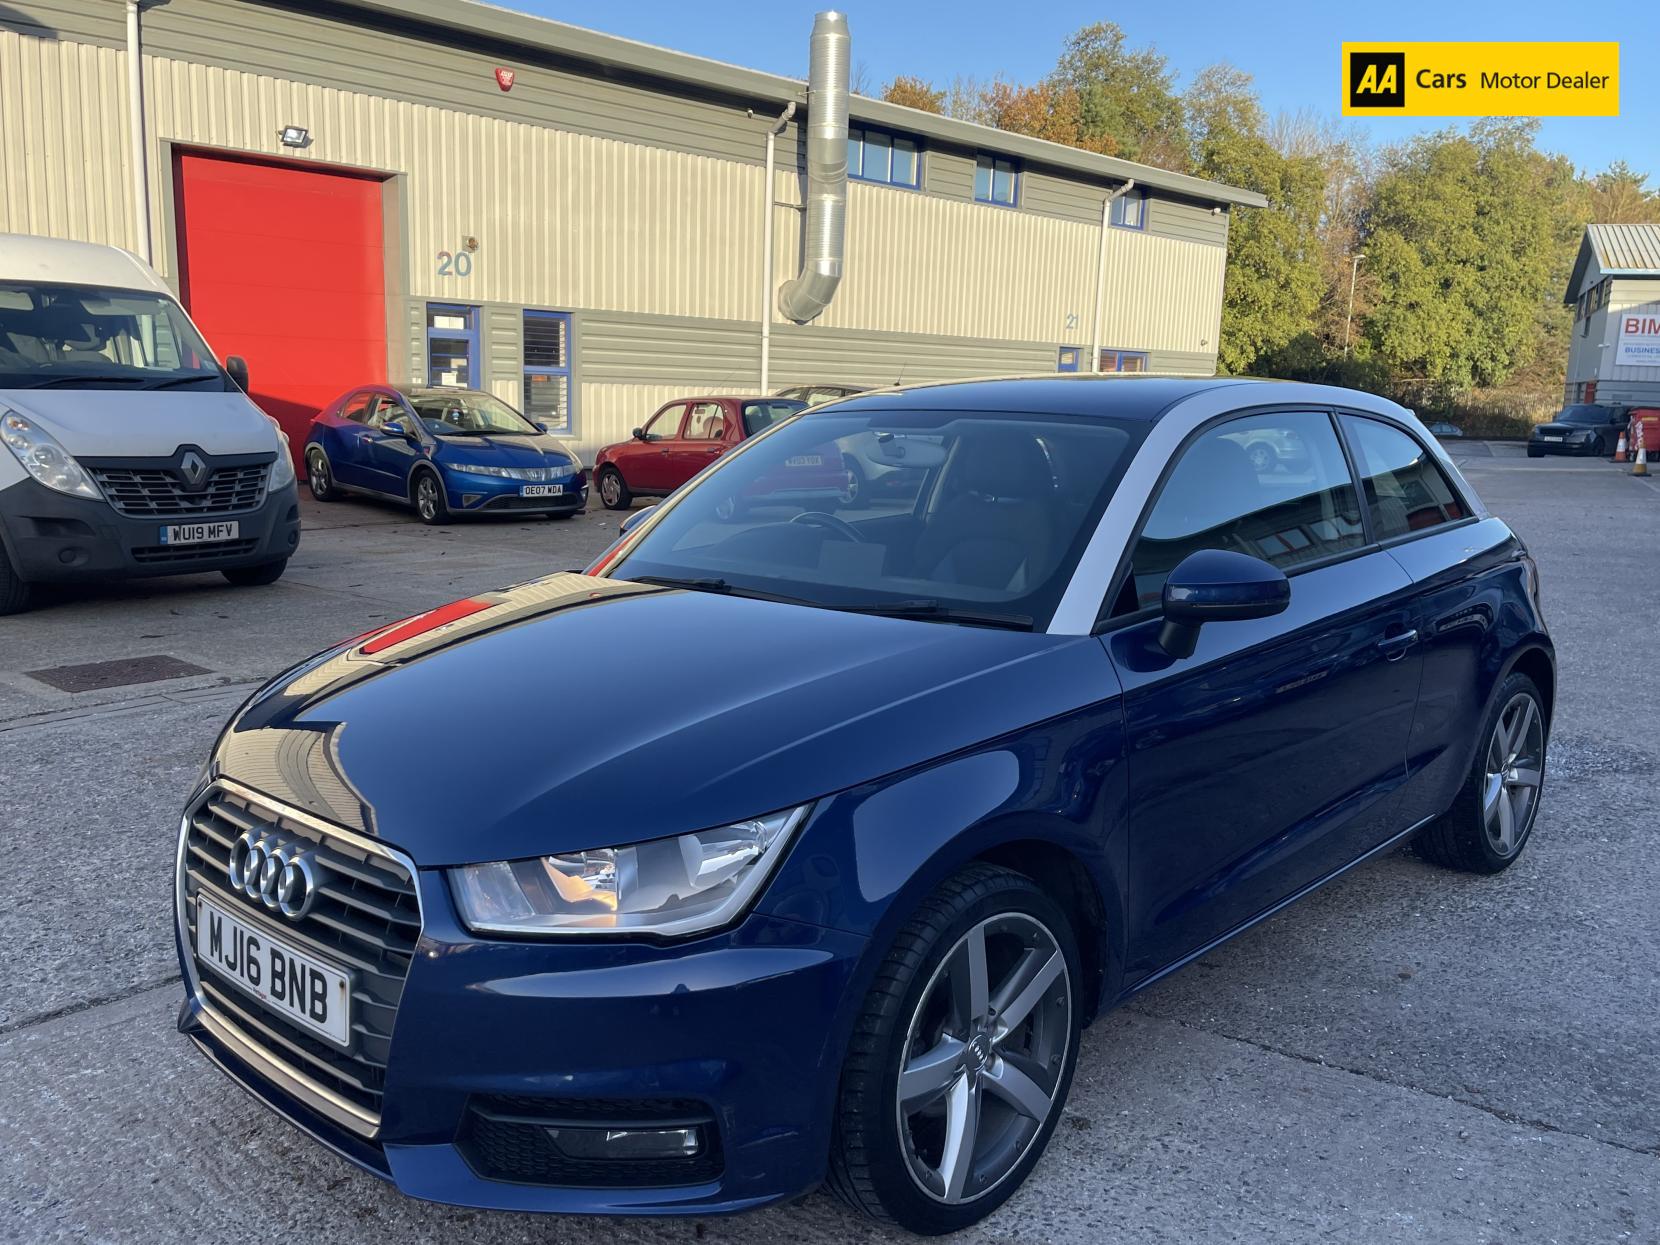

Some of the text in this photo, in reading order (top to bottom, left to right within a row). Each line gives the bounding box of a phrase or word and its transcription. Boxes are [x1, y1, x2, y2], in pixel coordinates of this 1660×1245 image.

[437, 251, 472, 277] 20
[1066, 313, 1079, 330] 21
[1624, 318, 1660, 335] BIM
[525, 485, 562, 495] OE07 WDA
[173, 523, 233, 542] WU19 MFV
[209, 911, 328, 1024] MJ16 BNB
